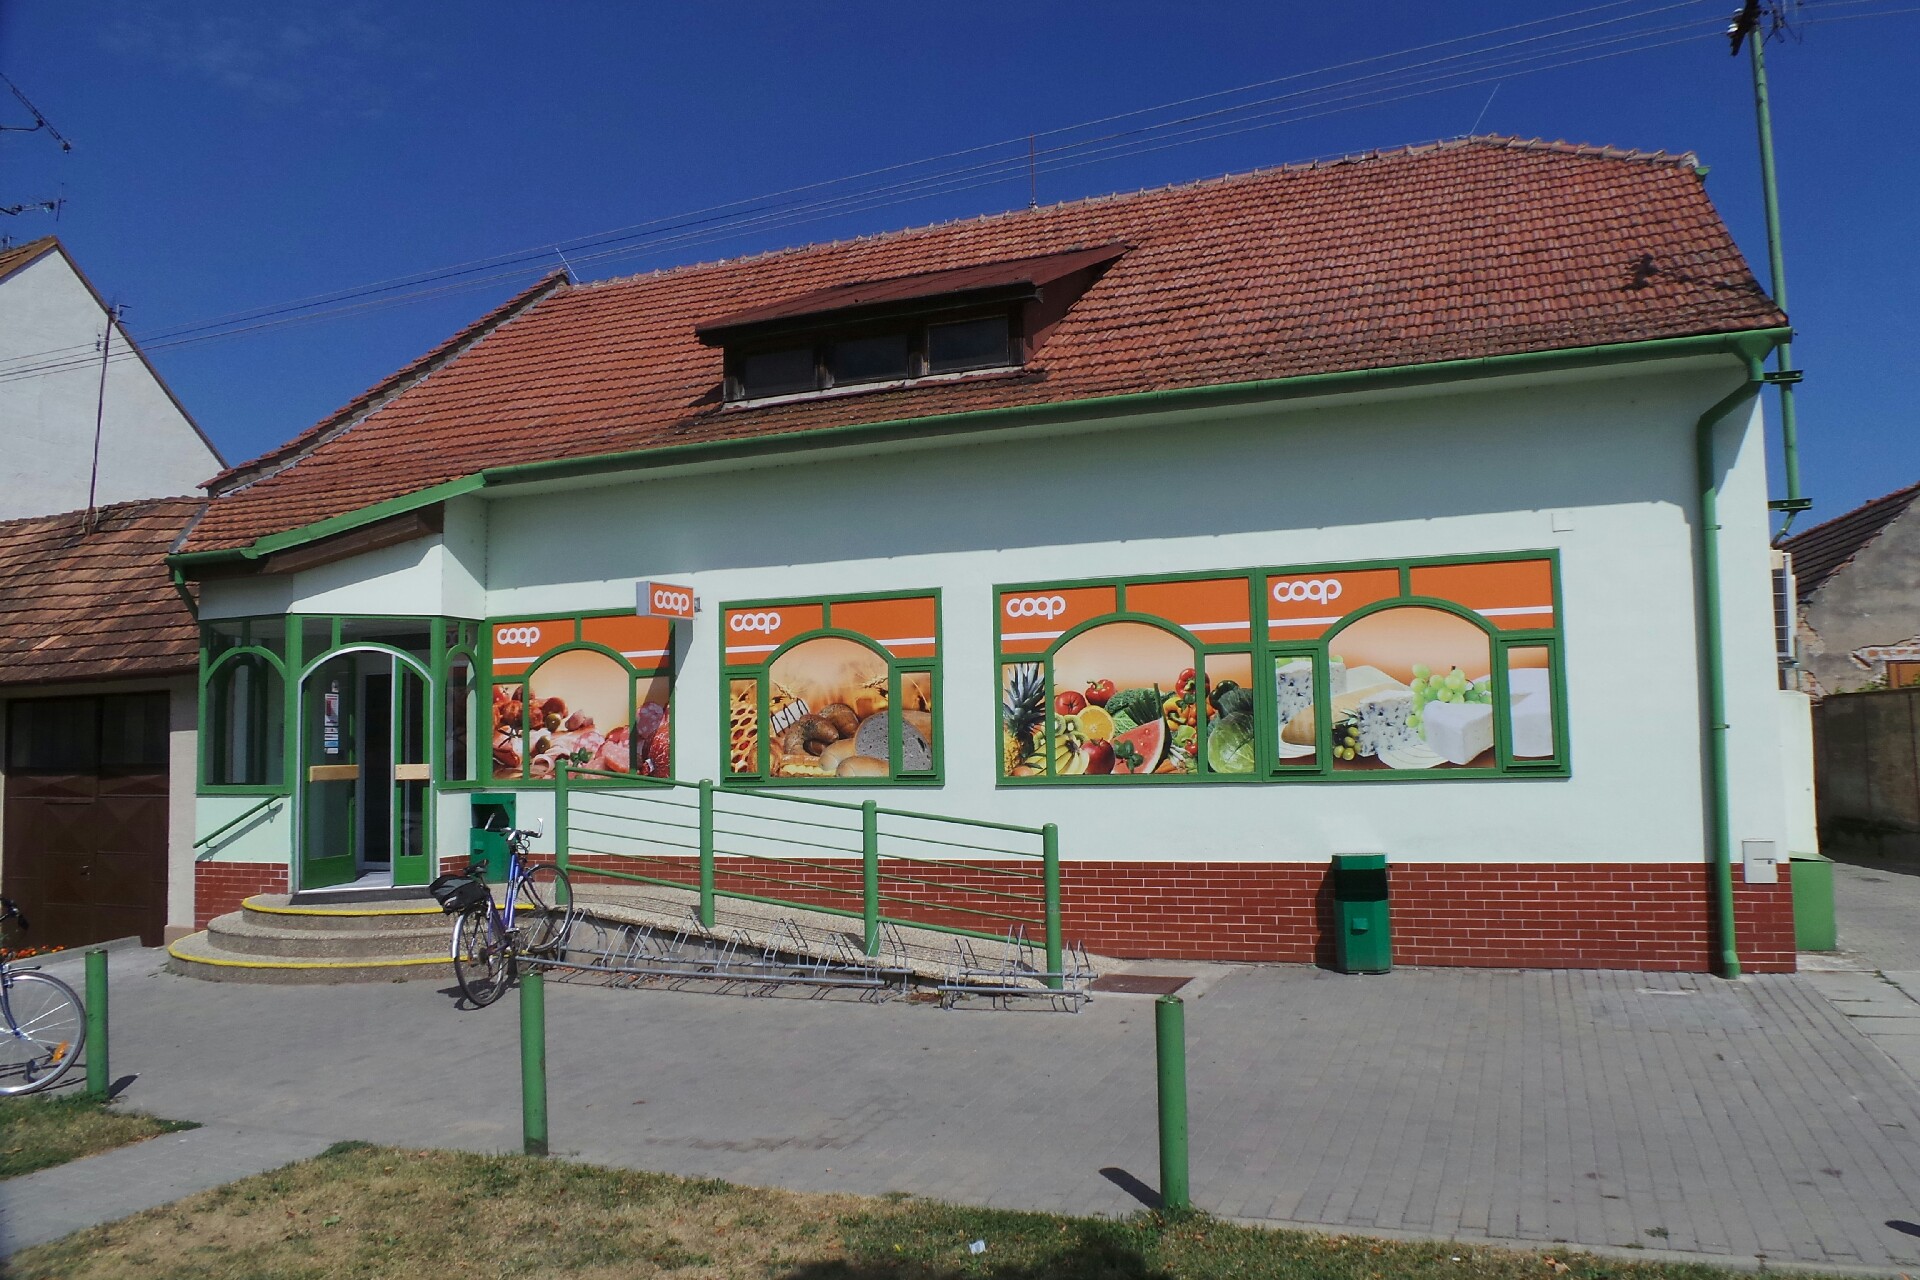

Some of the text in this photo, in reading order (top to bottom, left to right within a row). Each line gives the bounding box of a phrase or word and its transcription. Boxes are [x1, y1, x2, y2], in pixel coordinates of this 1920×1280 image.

[653, 588, 690, 615] coop
[1273, 578, 1343, 605] coop
[1006, 596, 1066, 620] coop
[729, 611, 781, 635] coop
[496, 627, 541, 647] coop
